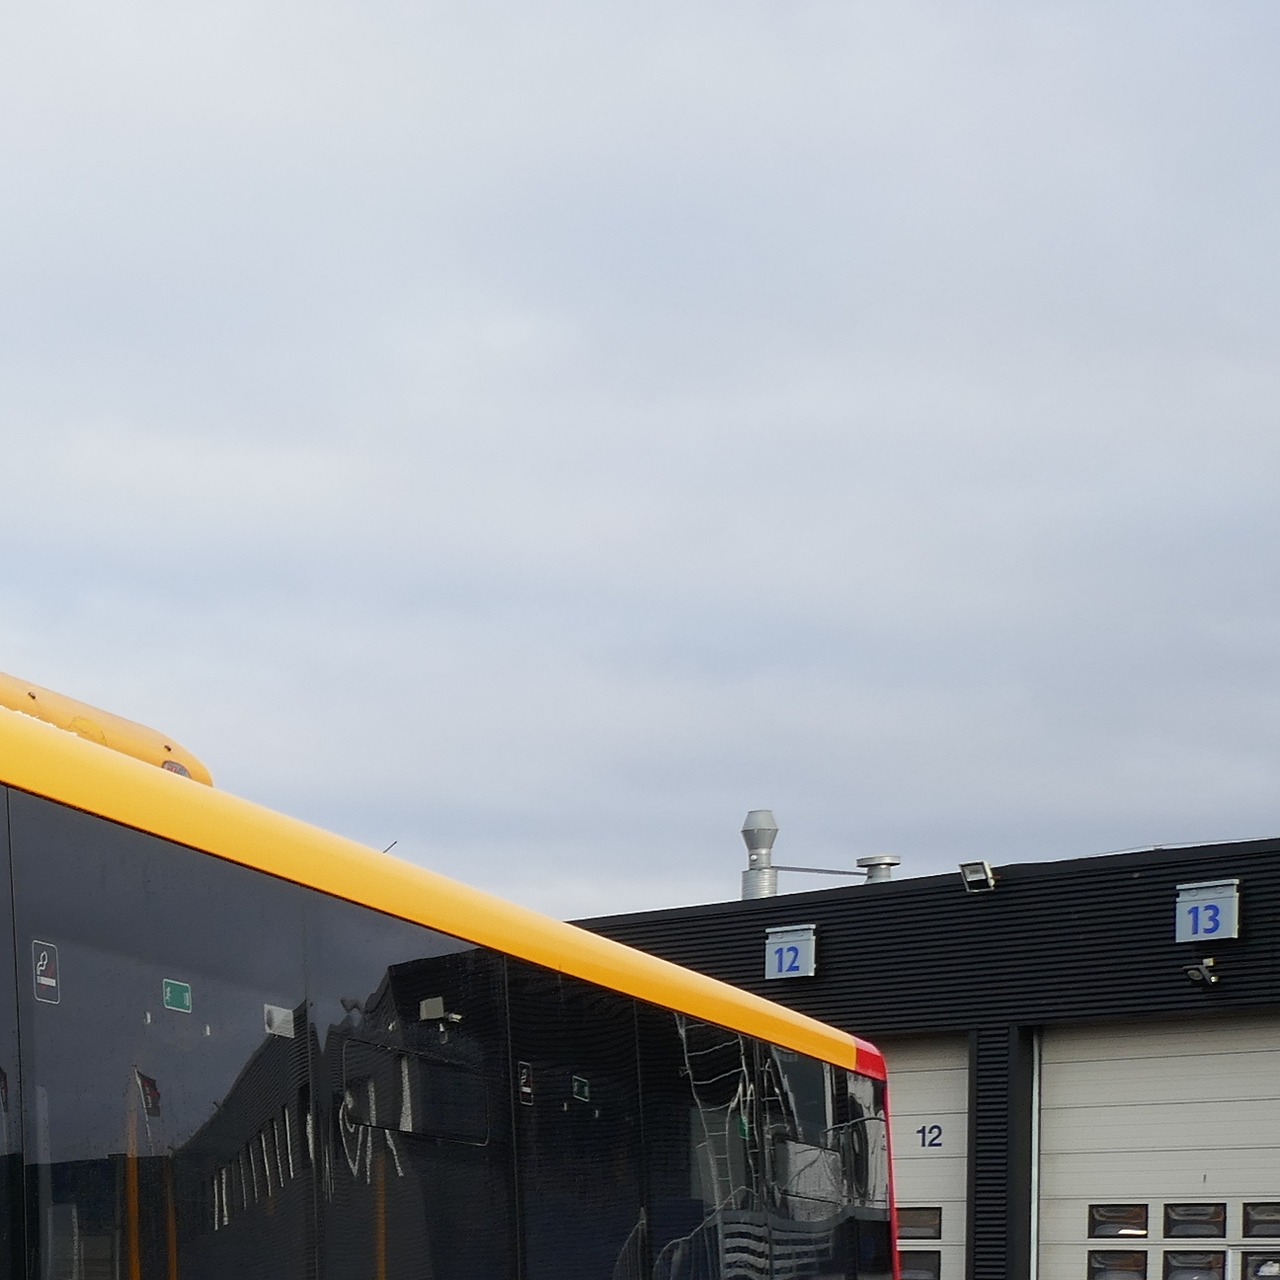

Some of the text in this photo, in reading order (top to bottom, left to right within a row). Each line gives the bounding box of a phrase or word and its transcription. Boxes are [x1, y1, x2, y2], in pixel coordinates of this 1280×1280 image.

[1187, 903, 1221, 936] 13
[773, 946, 800, 974] 12
[916, 1125, 943, 1148] 12
